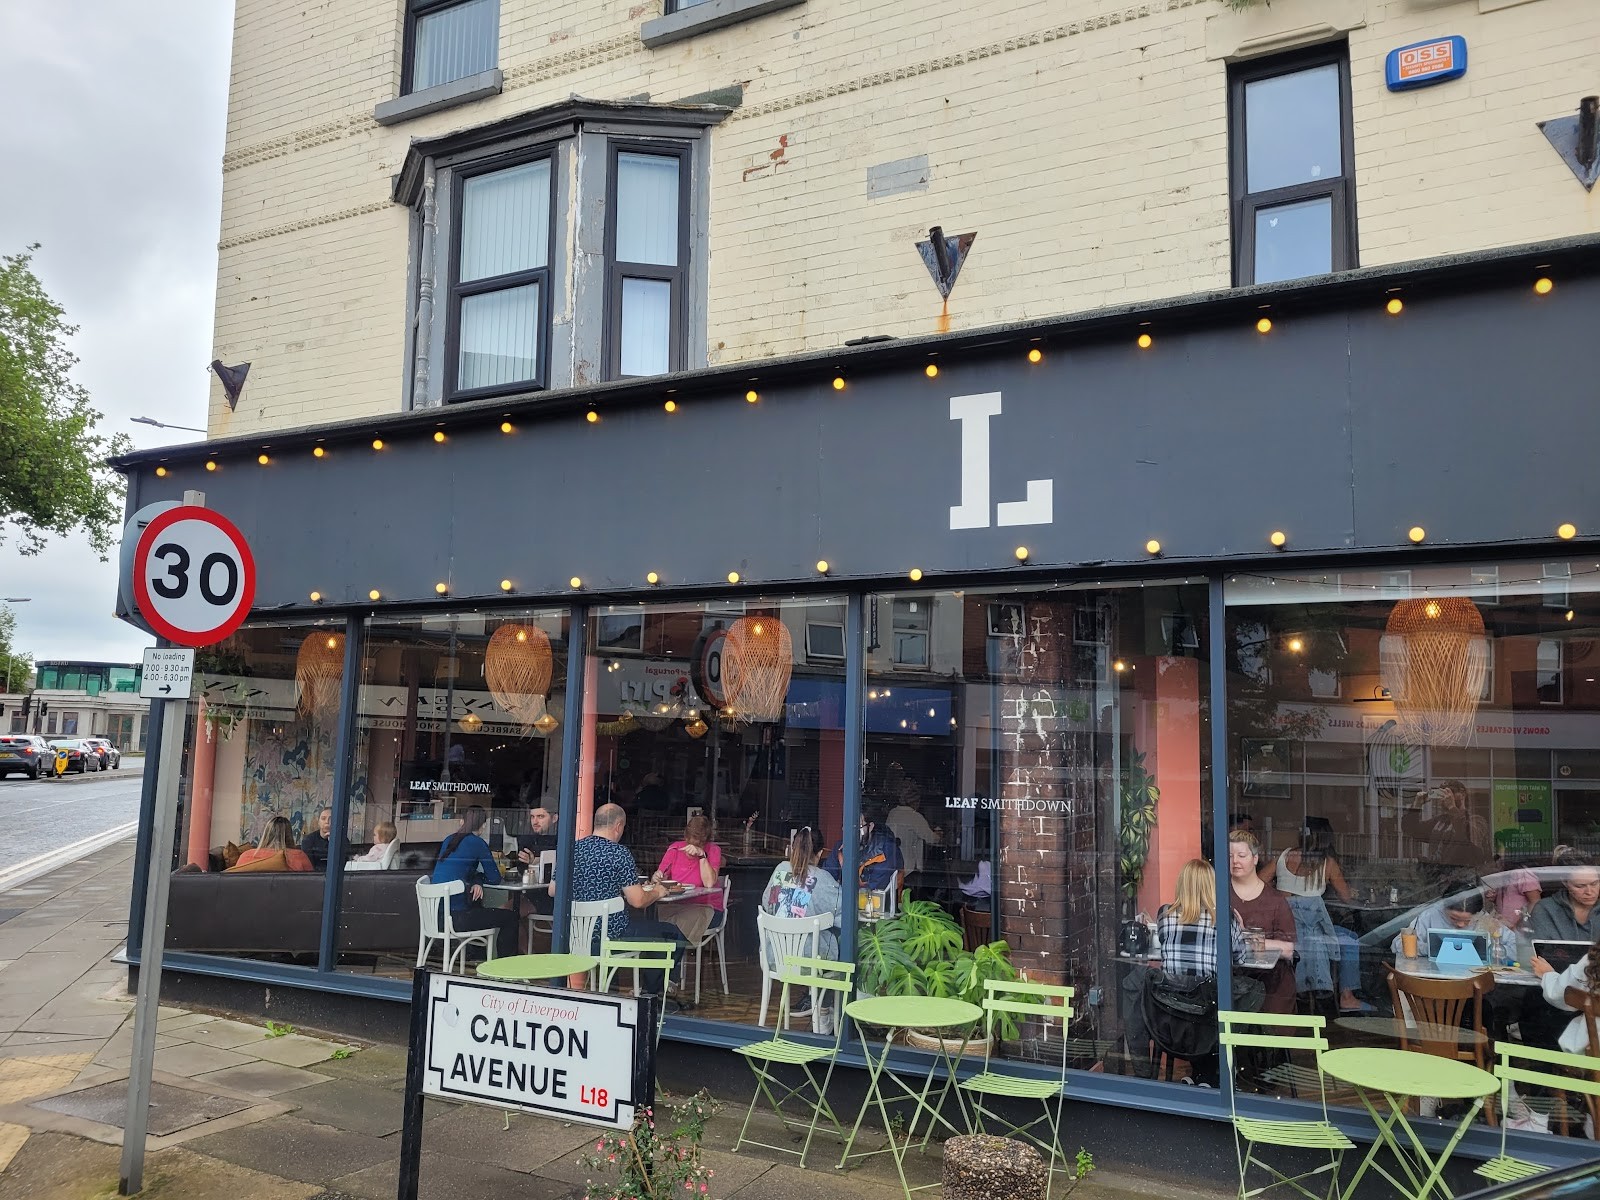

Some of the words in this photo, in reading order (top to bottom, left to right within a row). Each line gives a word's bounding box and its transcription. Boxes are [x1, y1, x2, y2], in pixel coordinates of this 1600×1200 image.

[1403, 46, 1448, 63] OSS
[950, 391, 1054, 530] L
[151, 543, 238, 606] 30
[152, 652, 161, 660] No
[162, 652, 186, 661] loading
[146, 664, 160, 672] 7.00
[144, 674, 160, 682] 4.00
[410, 780, 432, 790] LEAF
[432, 781, 491, 793] SMITHDOWN.
[945, 796, 978, 808] LEAF
[980, 798, 1075, 813] SMITHDOWN.
[481, 993, 505, 1013] City
[506, 997, 521, 1015] of
[522, 999, 580, 1021] Liverpool
[470, 1014, 589, 1060] CALTON
[450, 1052, 568, 1100] AVENUE
[580, 1084, 609, 1108] L18
